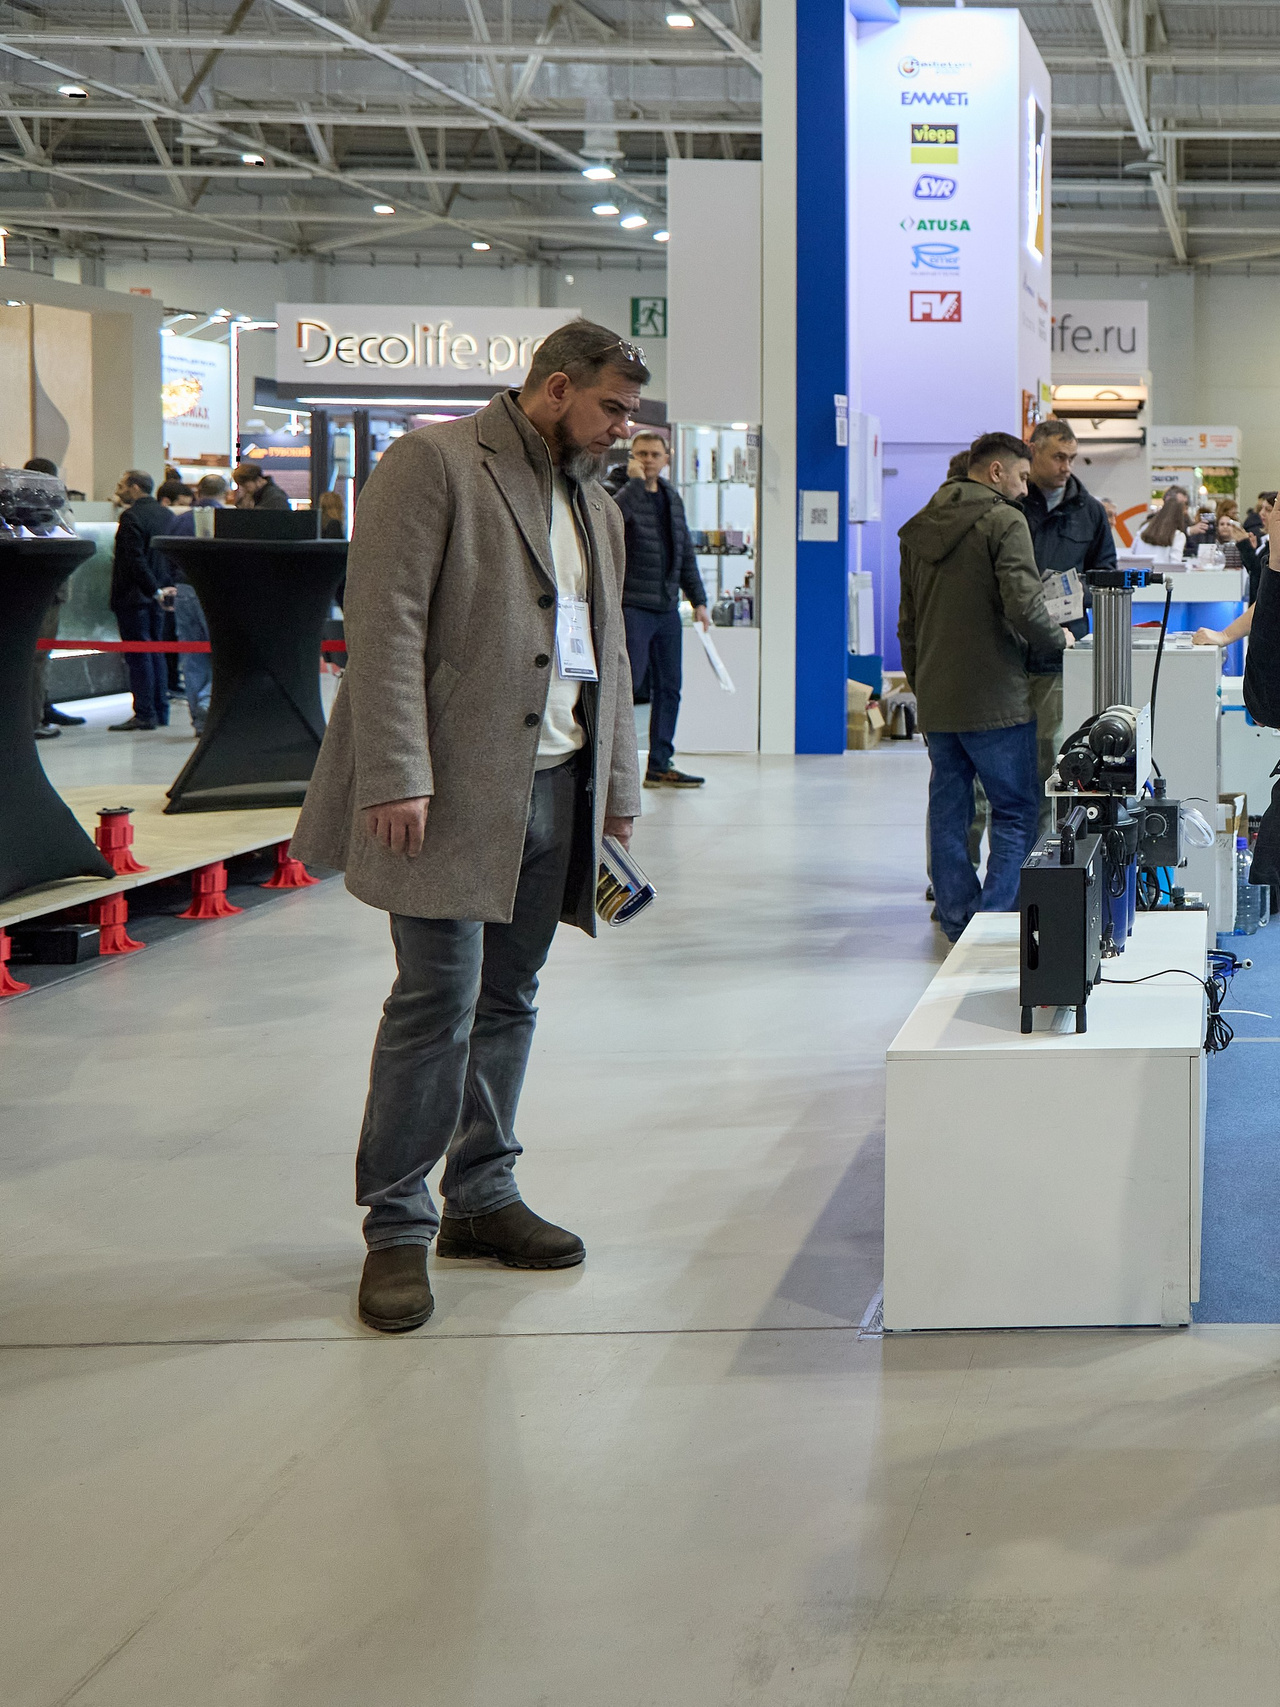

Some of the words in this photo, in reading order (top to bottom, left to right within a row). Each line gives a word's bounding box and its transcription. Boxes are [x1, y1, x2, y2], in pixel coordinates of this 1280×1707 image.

[913, 124, 956, 144] viega
[916, 178, 955, 198] SYR
[917, 219, 971, 231] ATUSA
